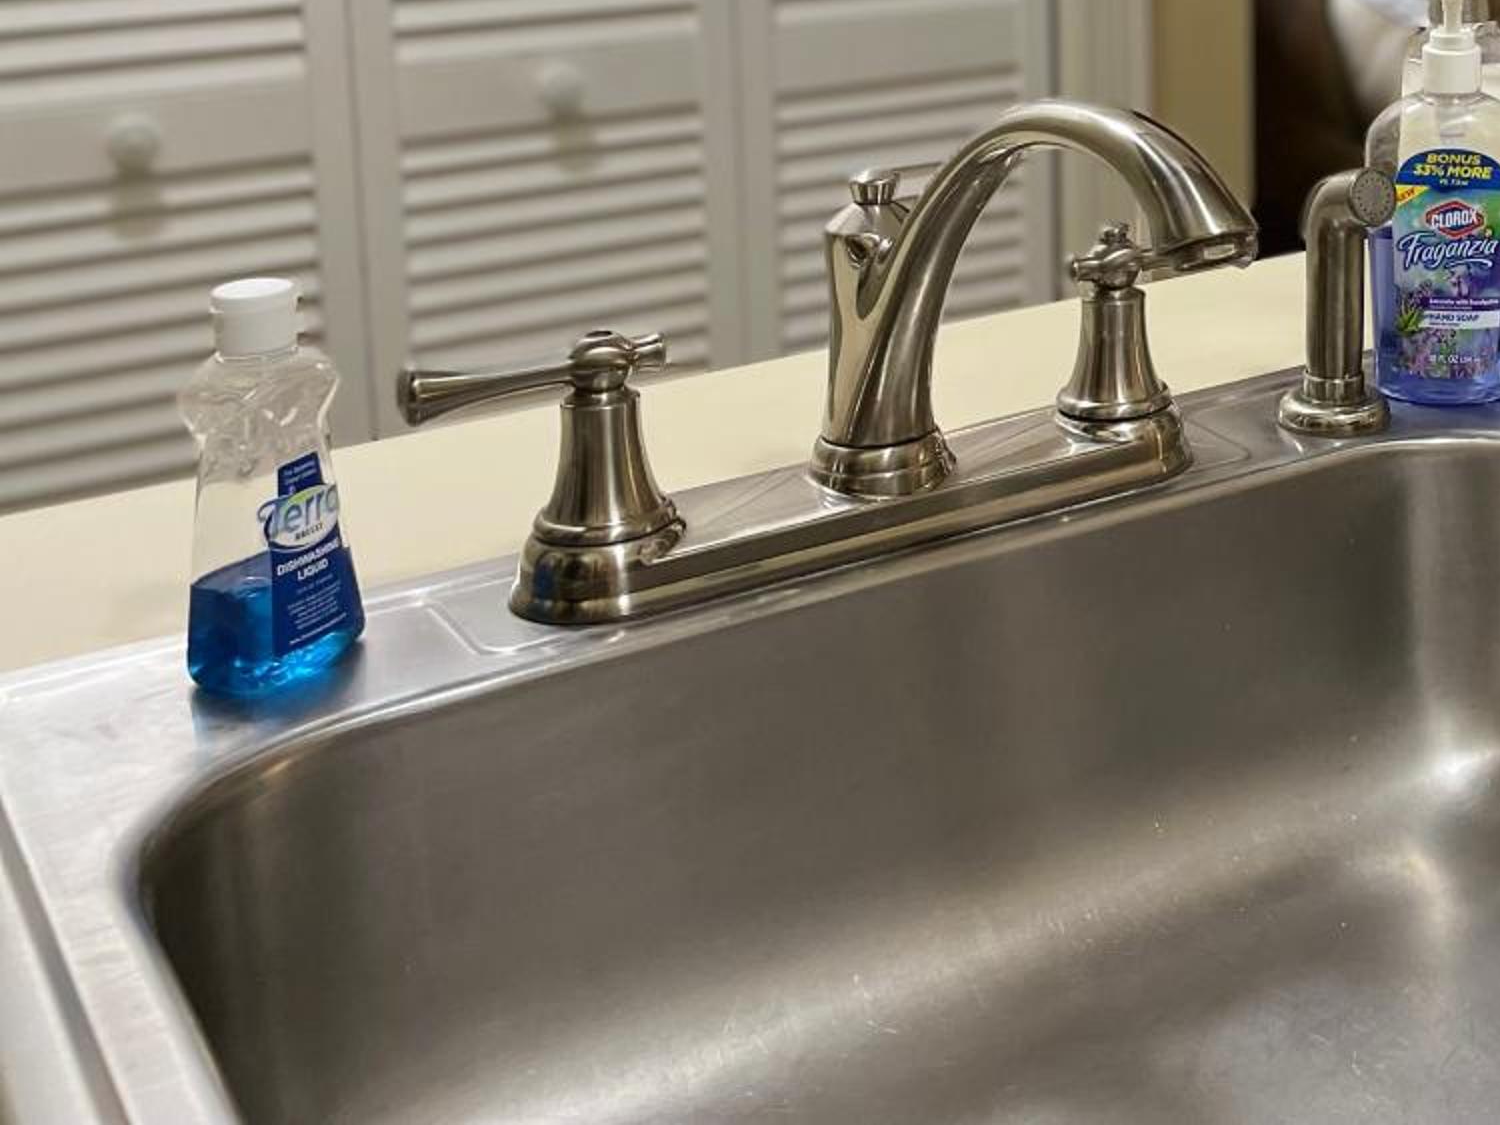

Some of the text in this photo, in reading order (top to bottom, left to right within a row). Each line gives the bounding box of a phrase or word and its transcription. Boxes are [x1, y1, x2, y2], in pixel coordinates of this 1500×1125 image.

[1426, 153, 1481, 166] BONUS
[1413, 163, 1493, 180] 33% MORE
[1431, 206, 1478, 229] CLOROX
[1399, 229, 1499, 269] Fraganzia
[297, 558, 329, 581] LIQUID
